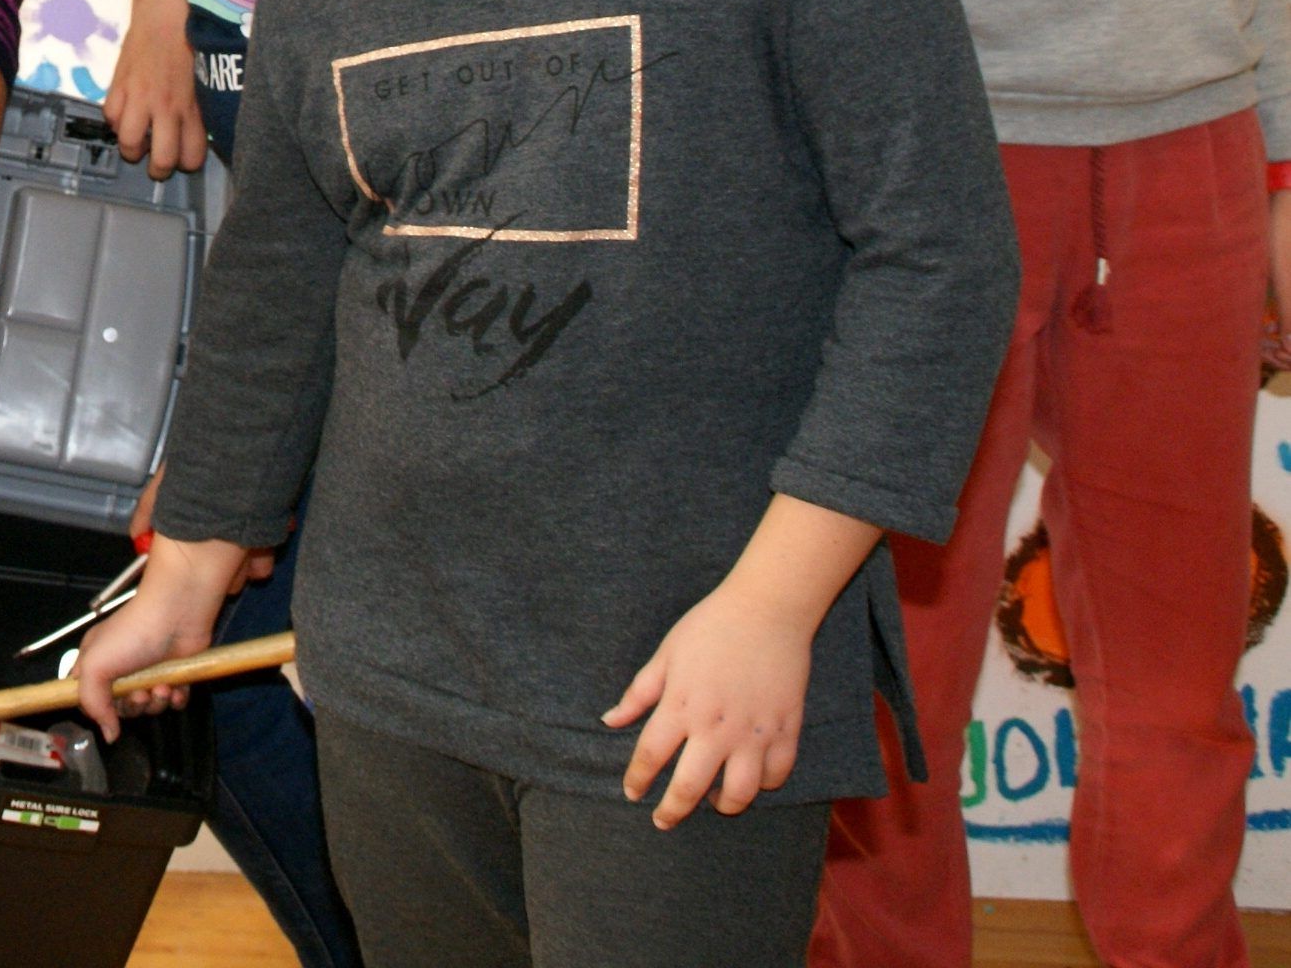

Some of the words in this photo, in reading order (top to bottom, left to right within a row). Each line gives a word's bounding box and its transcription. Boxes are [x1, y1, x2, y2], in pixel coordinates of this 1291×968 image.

[210, 53, 244, 91] ARE
[374, 71, 430, 100] GET
[456, 59, 514, 85] OUT
[545, 52, 581, 76] OF
[415, 188, 497, 217] OWN
[10, 799, 44, 811] METAL
[72, 807, 98, 818] LOCK
